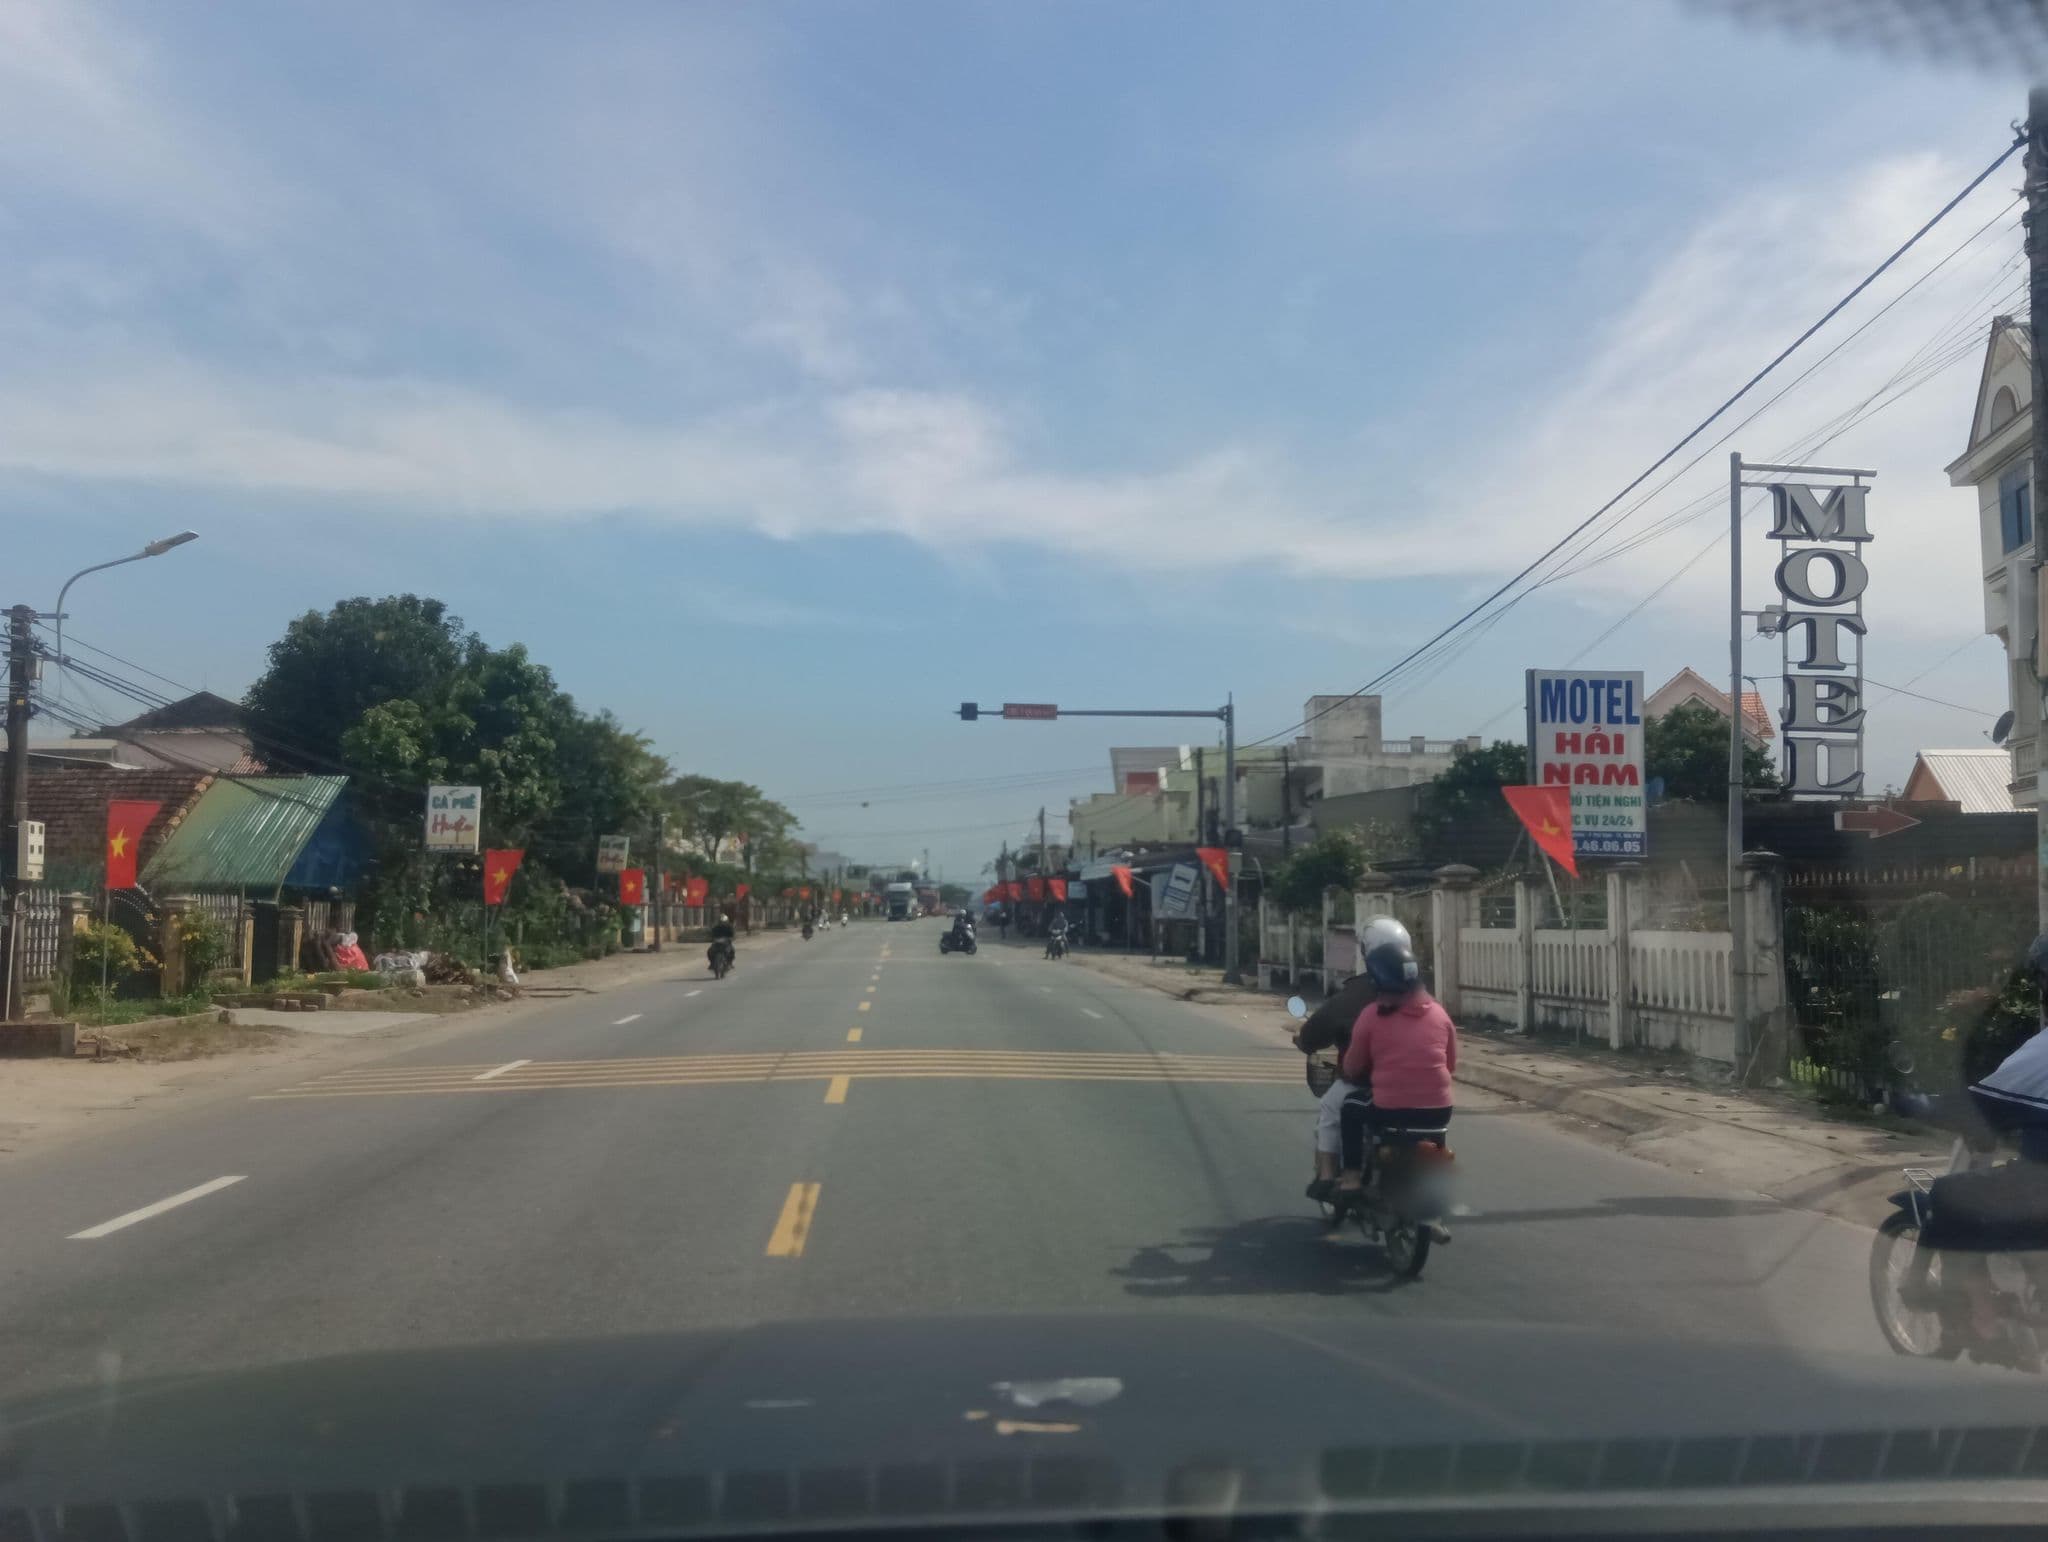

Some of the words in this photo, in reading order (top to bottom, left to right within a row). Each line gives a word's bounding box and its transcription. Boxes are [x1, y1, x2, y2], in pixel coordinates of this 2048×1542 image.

[1766, 484, 1875, 796] MOTEL
[1540, 678, 1640, 725] MOTEL
[1555, 726, 1625, 755] HẢI
[1543, 762, 1639, 786] NAM
[1585, 792, 1611, 809] TIỆN
[1614, 794, 1641, 808] NGHI
[1584, 814, 1599, 828] VỤ
[1602, 814, 1634, 827] 24/24
